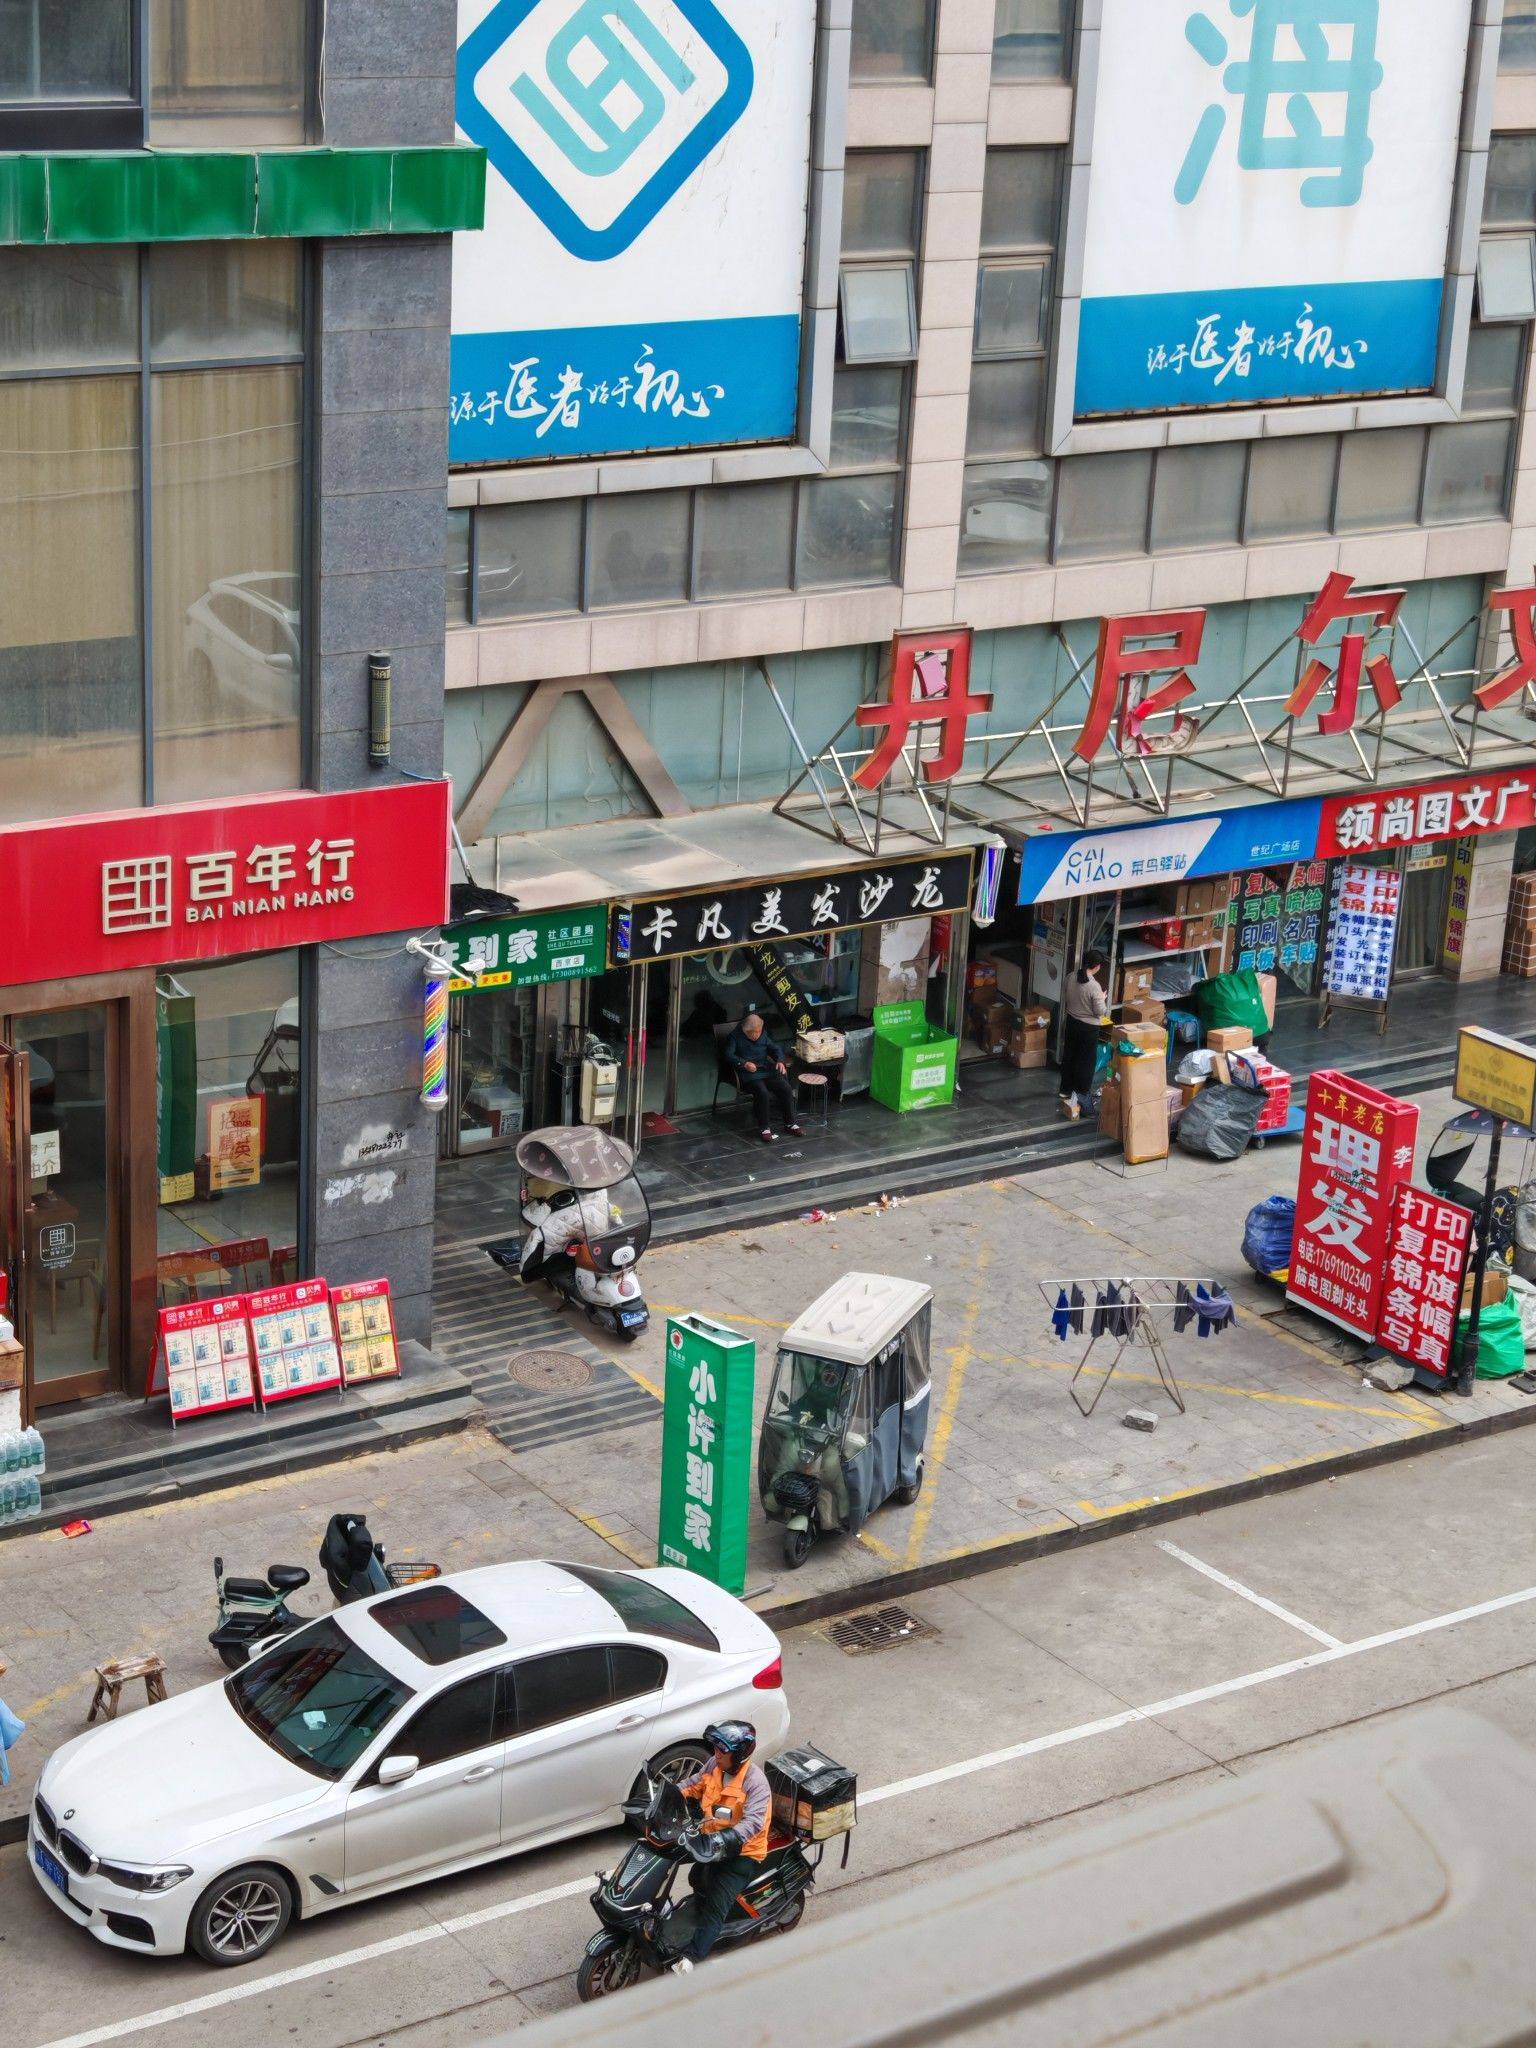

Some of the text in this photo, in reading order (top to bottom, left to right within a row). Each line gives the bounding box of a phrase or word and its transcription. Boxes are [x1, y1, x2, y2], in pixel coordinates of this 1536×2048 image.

[1174, 0, 1384, 208] 海
[1147, 302, 1368, 386] 源于医者始于初心
[1335, 779, 1536, 849] 领尚图文广
[186, 838, 355, 902] 百年行
[1068, 848, 1104, 868] CAI
[1131, 853, 1188, 877] 菜鸟驿站
[1250, 840, 1301, 856] 世纪广场店
[1065, 862, 1123, 886] NIAO
[1343, 881, 1399, 900] 复印
[1344, 865, 1401, 884] 打印
[186, 886, 355, 923] BAI NIAN HANG
[641, 866, 944, 954] 卡凡美发沙龙
[1242, 895, 1281, 921] 写真
[1241, 919, 1280, 947] 印刷
[1283, 914, 1320, 941] 名片
[1280, 939, 1318, 967] 车贴
[1317, 1088, 1384, 1135] 十年老店
[1304, 1111, 1381, 1265] 理发
[1399, 1190, 1467, 1242] 打印
[1393, 1223, 1462, 1274] 复印
[1389, 1252, 1458, 1309] 锦旗
[1386, 1286, 1453, 1342] 条幅
[1381, 1315, 1448, 1371] 写真
[683, 1359, 717, 1552] 小许到家
